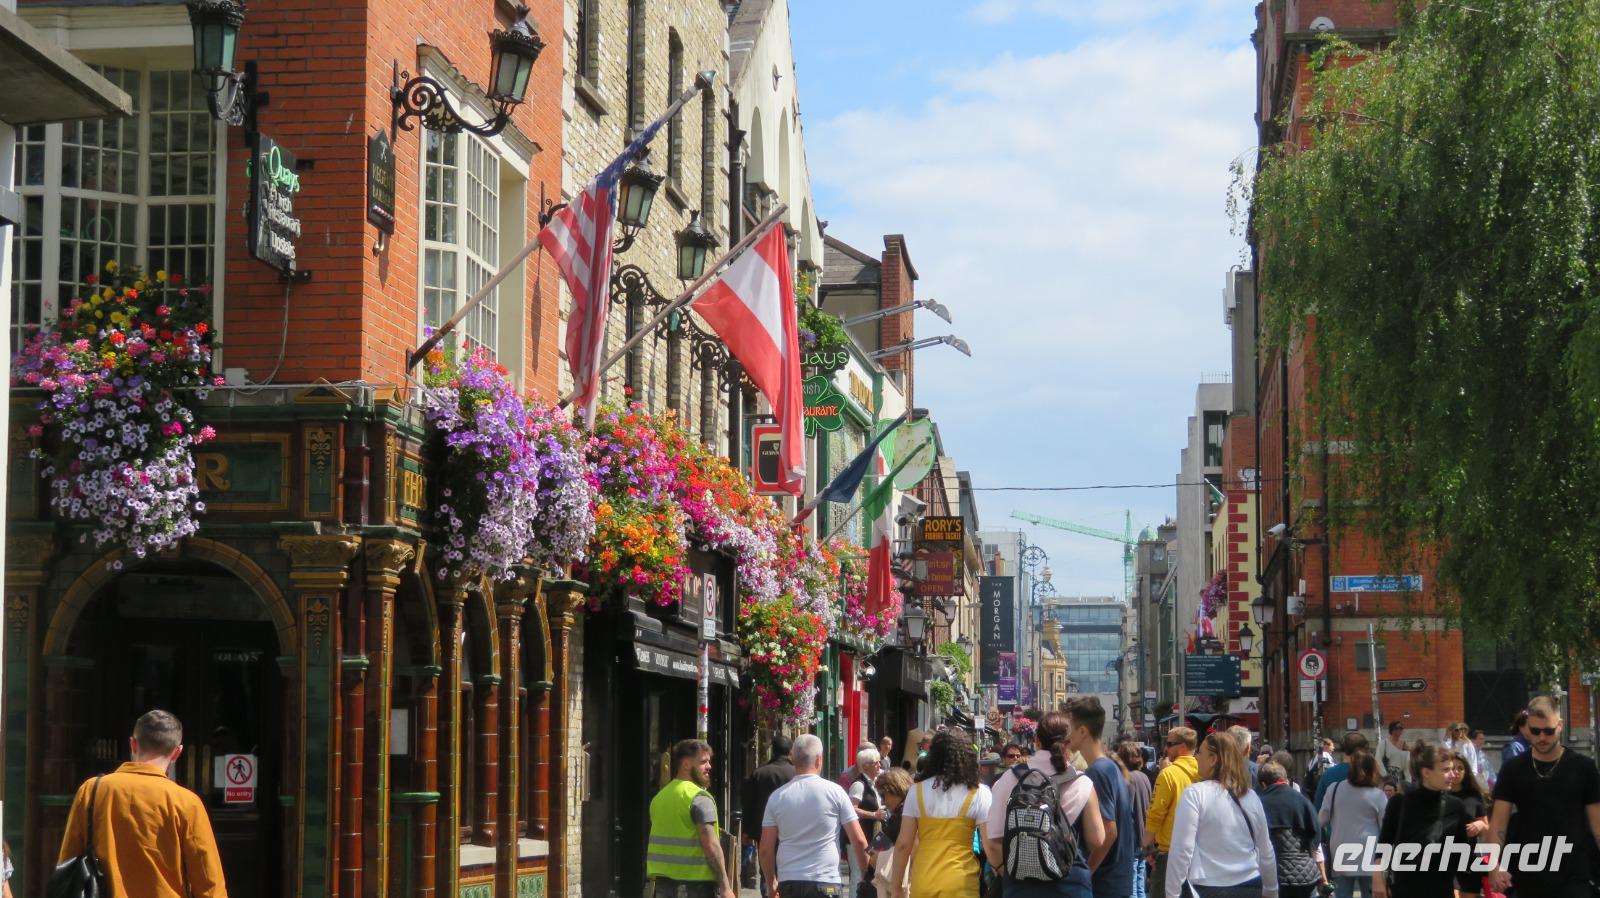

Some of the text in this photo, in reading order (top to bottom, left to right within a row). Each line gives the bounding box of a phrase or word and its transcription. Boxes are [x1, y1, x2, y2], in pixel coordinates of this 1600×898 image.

[270, 146, 300, 192] Quays
[800, 351, 848, 370] uays
[924, 519, 962, 532] RORY'S
[920, 583, 944, 593] OPEN
[993, 589, 1001, 640] MORGAN
[237, 791, 252, 799] entry
